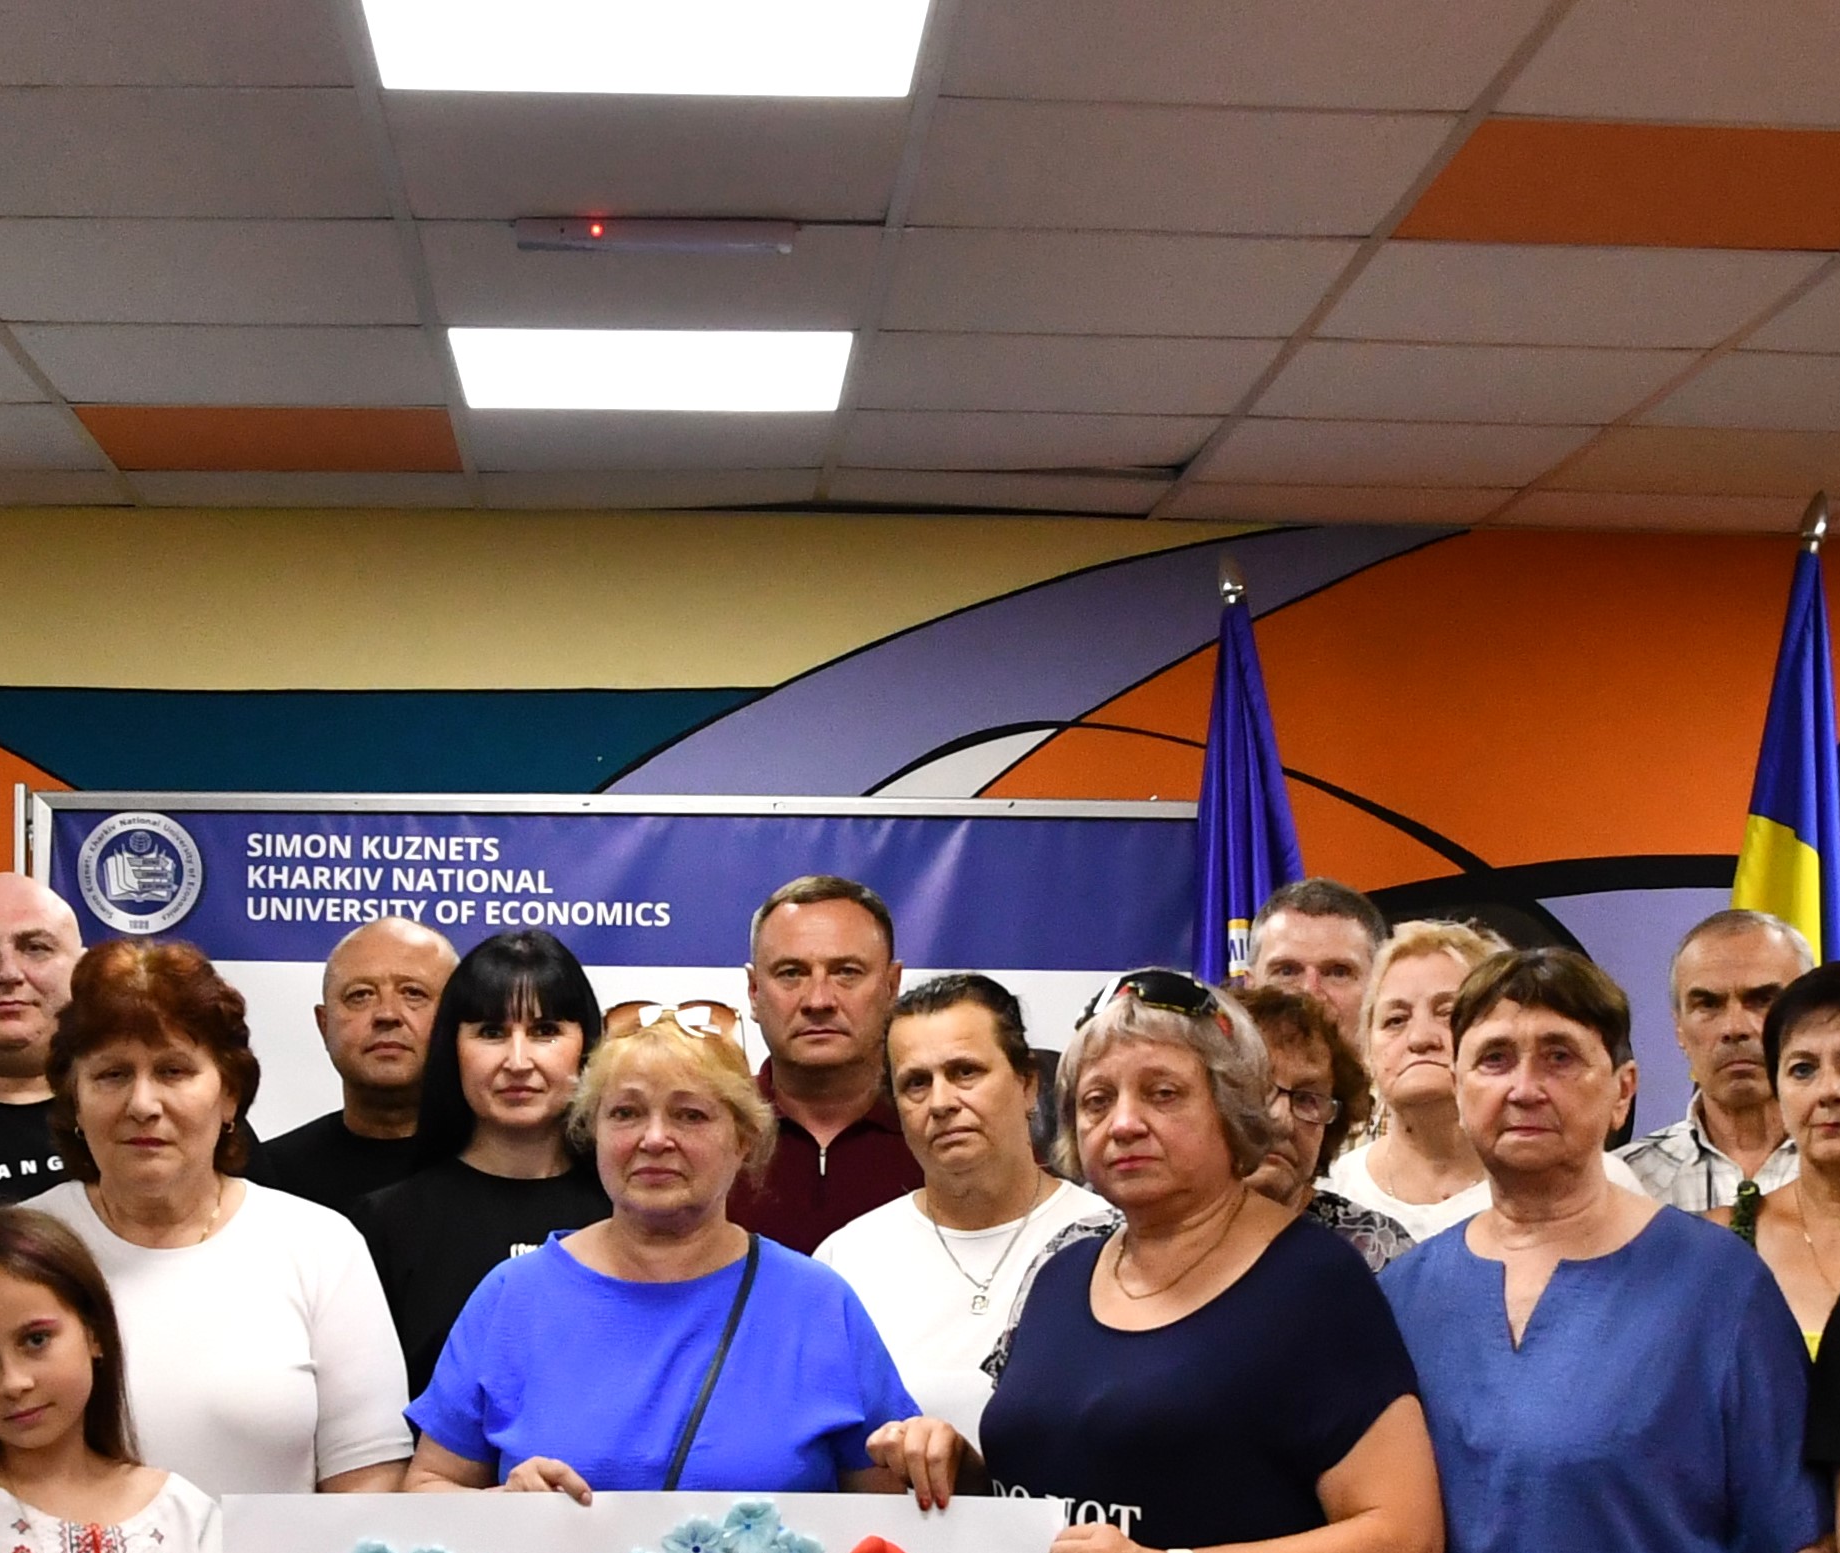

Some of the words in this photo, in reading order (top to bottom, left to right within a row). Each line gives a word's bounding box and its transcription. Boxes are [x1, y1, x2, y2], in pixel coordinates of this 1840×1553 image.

[247, 833, 351, 859] SIMON
[362, 836, 499, 862] KUZNETS
[247, 865, 383, 891] KHARKIV
[393, 868, 553, 894] NATIONAL
[247, 897, 425, 924] UNIVERSITY
[435, 900, 476, 924] OF
[485, 901, 670, 927] ECONOMICS
